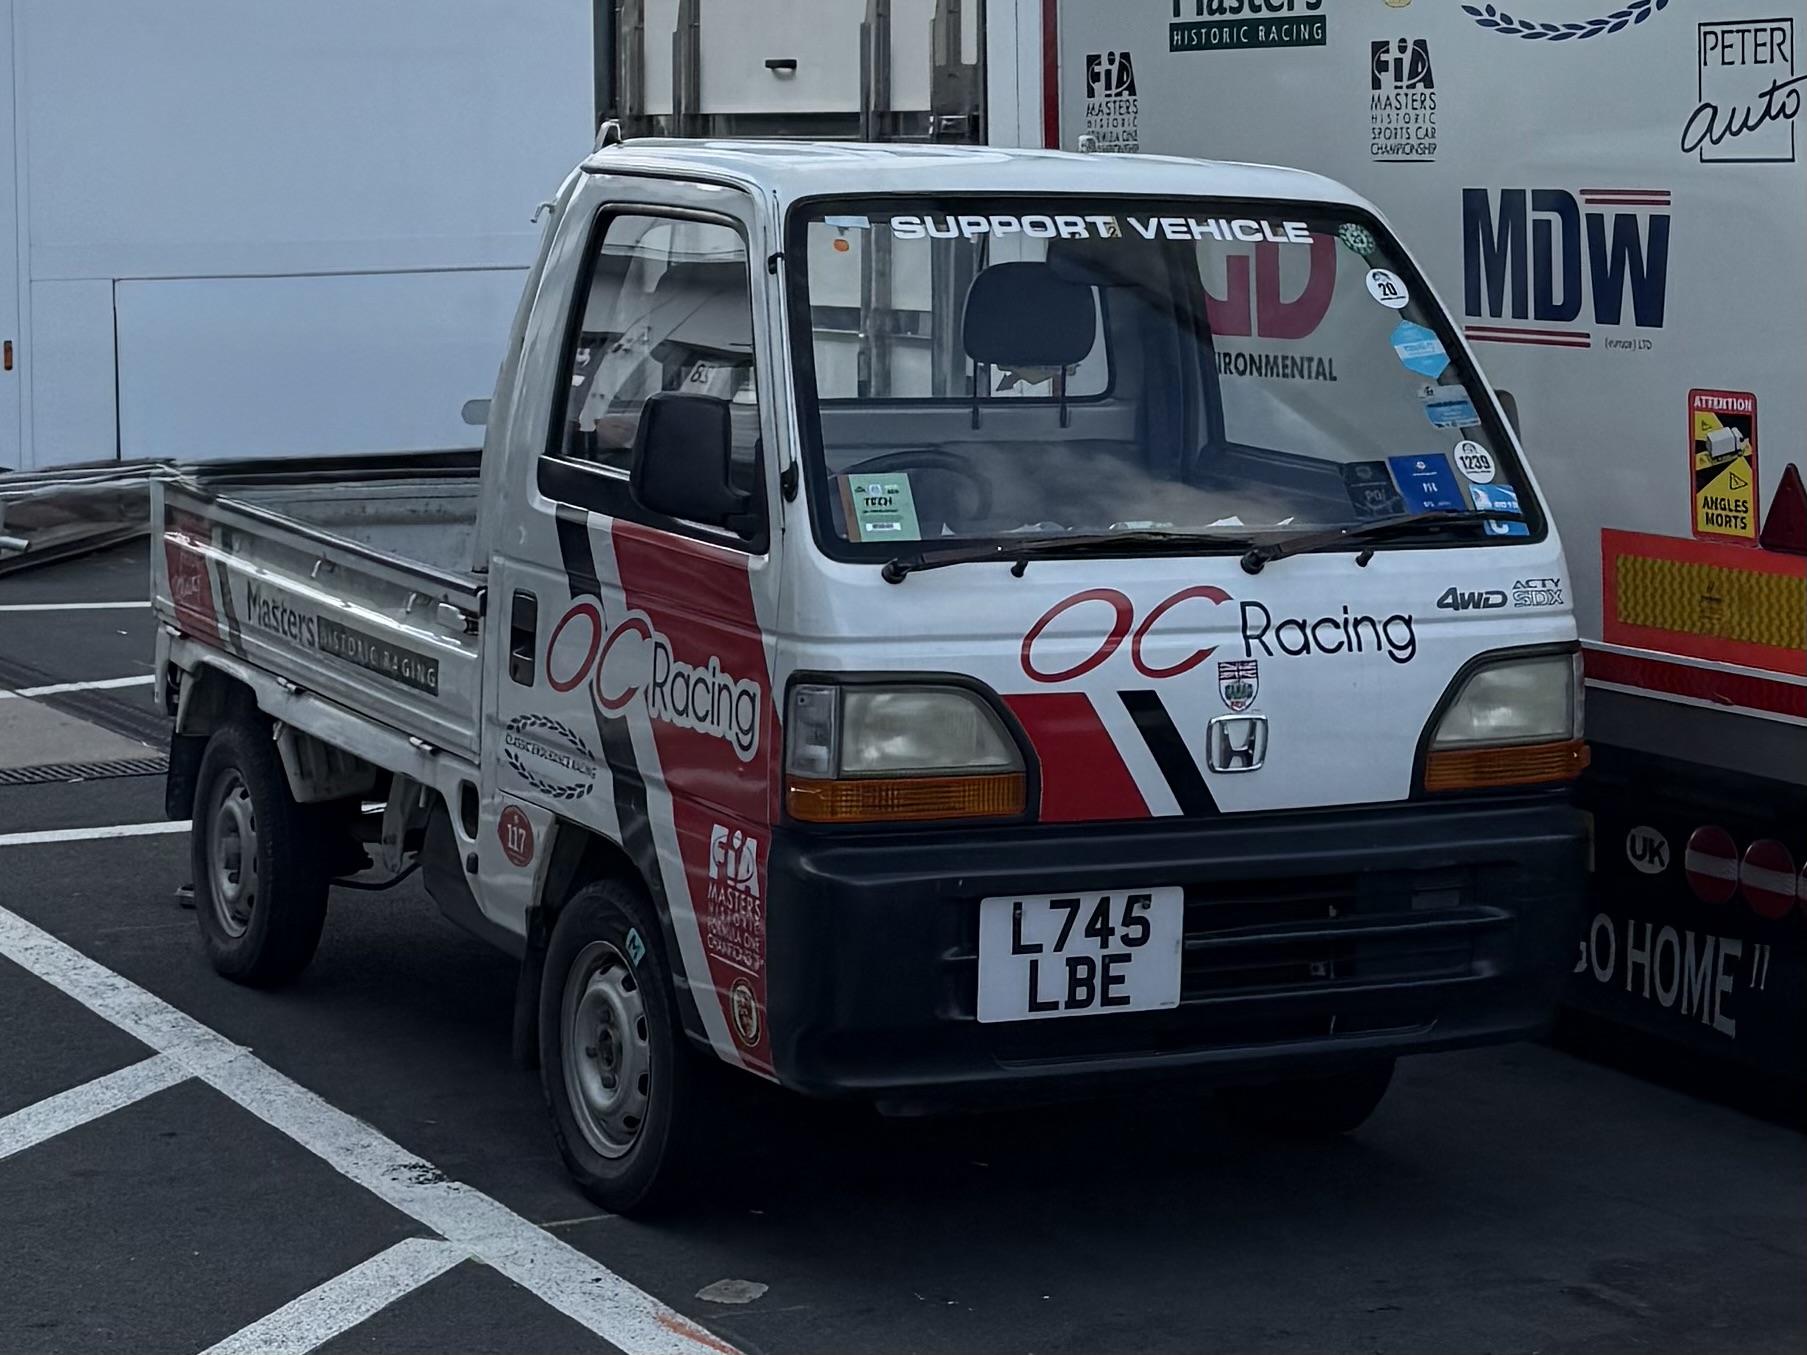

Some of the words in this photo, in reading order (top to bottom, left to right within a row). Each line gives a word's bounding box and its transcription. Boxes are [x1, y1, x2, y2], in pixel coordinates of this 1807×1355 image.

[1173, 26, 1249, 46] HISTORIC
[1258, 23, 1322, 42] RACING
[1703, 27, 1789, 67] PETER
[1086, 99, 1138, 117] MASTERS
[1370, 92, 1437, 111] MASTERS
[1371, 112, 1436, 125] HISTORIC
[1681, 75, 1807, 153] auto
[1371, 127, 1411, 140] SPORTS
[1415, 126, 1437, 140] CAR
[890, 215, 1119, 240] SUPPORT
[1127, 216, 1314, 244] VEHICLE
[1461, 188, 1671, 328] MDW
[1377, 282, 1397, 297] 20
[1694, 395, 1752, 411] ATTENTION
[1459, 454, 1491, 470] 1239
[1702, 495, 1749, 514] ANGLES
[1705, 512, 1747, 531] MORTS
[1512, 578, 1561, 589] ACTY
[1436, 587, 1508, 611] 4WD
[1512, 589, 1564, 608] SDX
[247, 579, 316, 648] Masters
[1019, 585, 1236, 684] OC
[1240, 601, 1416, 664] Racing
[546, 603, 653, 710] OC
[651, 641, 757, 752] Racing
[1630, 832, 1666, 868] UK
[708, 882, 761, 921] MASTERS
[1011, 893, 1152, 956] L745
[1028, 952, 1133, 1013] LBE
[1625, 919, 1743, 1040] HOME
